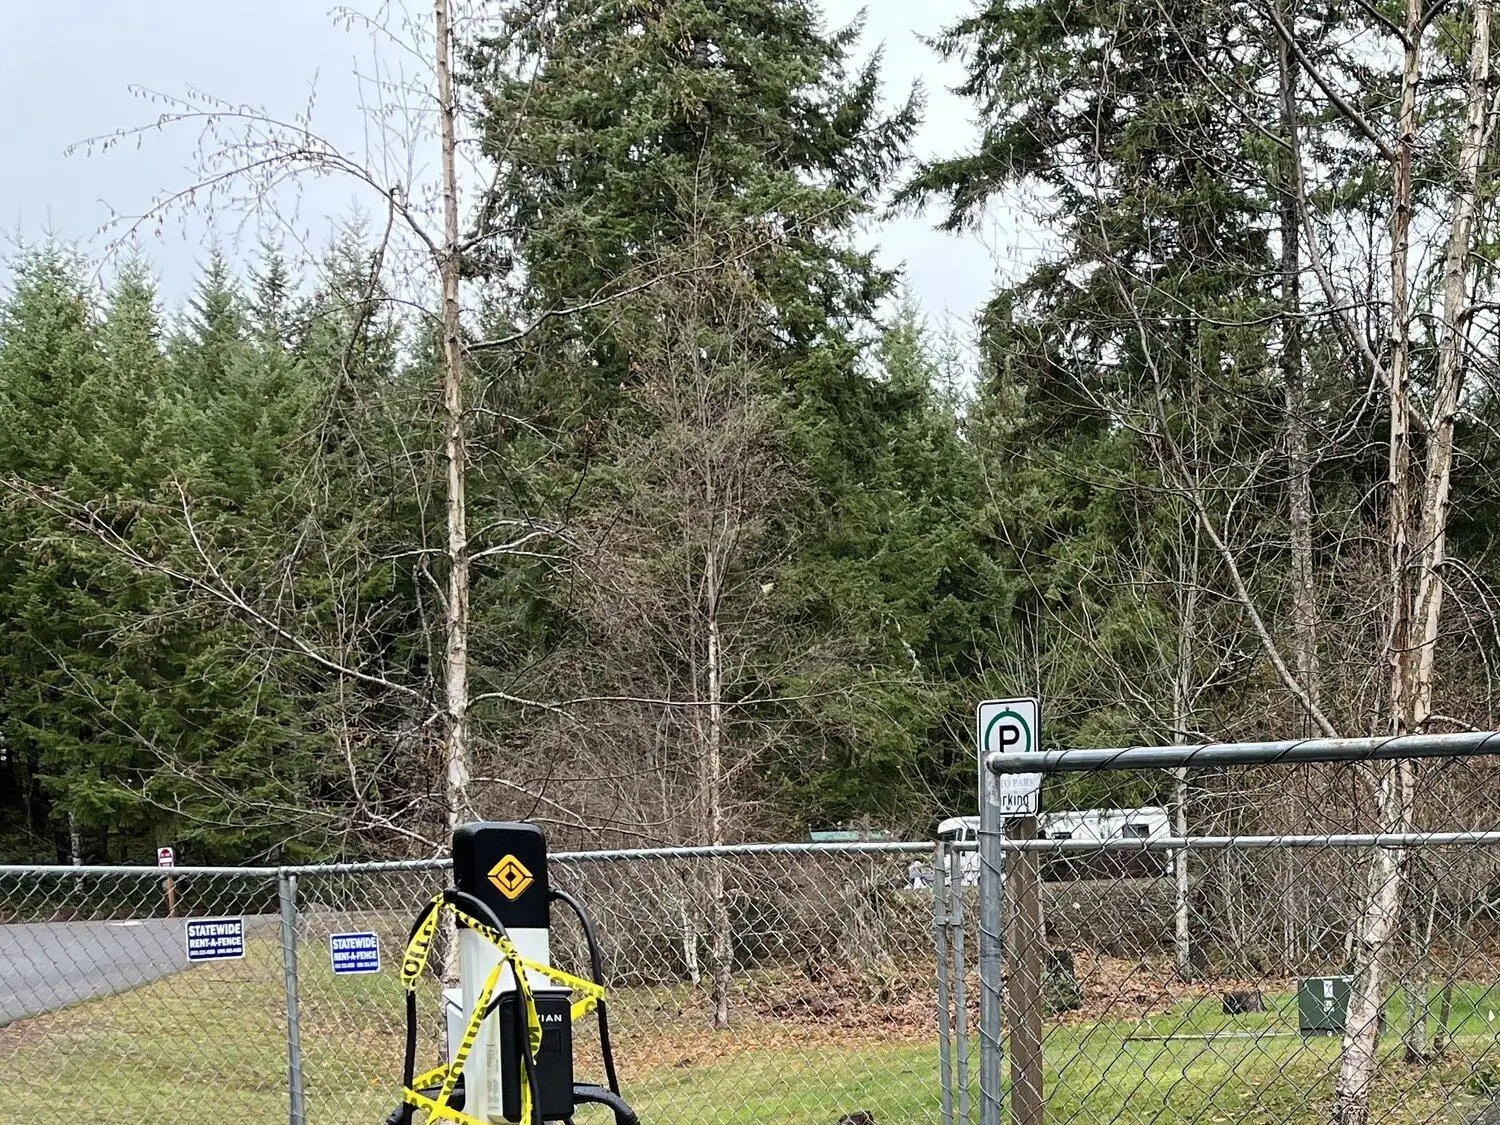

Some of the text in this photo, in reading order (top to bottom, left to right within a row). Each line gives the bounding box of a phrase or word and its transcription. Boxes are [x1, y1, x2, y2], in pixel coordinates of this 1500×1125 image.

[999, 724, 1020, 753] P
[1002, 793, 1030, 811] rking
[188, 923, 241, 937] STATEWIDE
[190, 936, 241, 949] RENT-A-FENCE
[332, 937, 377, 949] STATEWIDE
[537, 1014, 562, 1022] IAN
